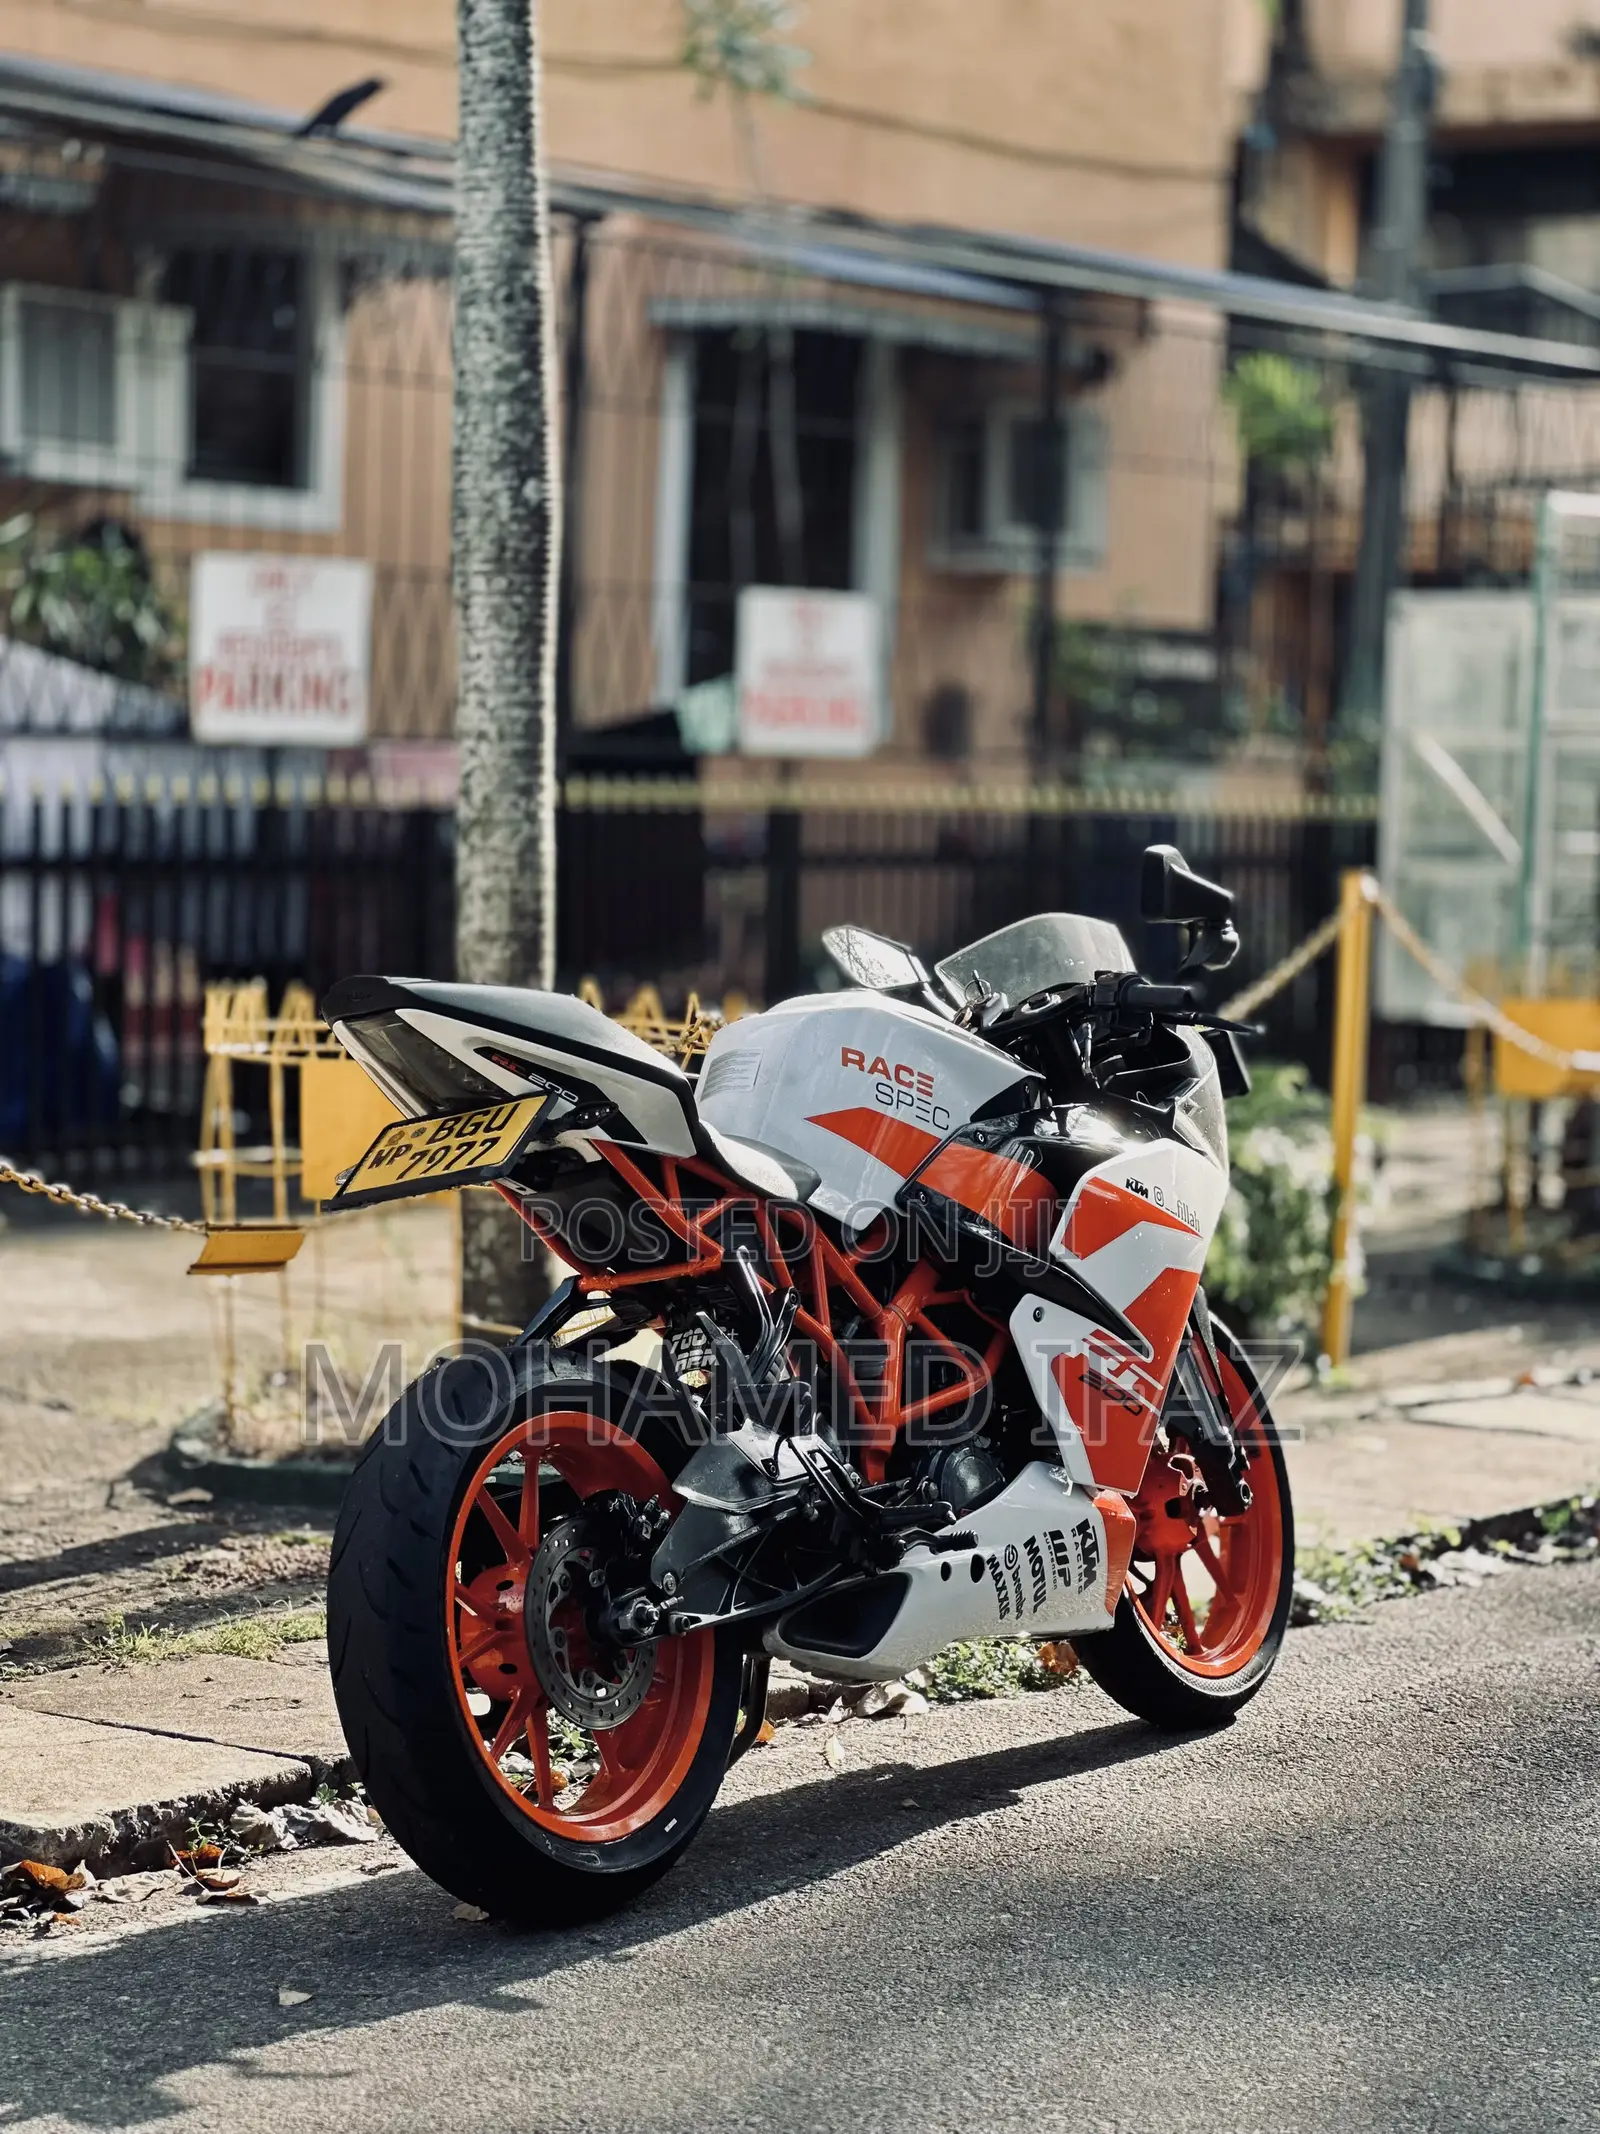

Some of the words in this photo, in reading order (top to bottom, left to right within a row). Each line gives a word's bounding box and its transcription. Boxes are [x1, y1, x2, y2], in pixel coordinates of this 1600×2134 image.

[528, 1072, 579, 1103] 200
[841, 1046, 935, 1098] RACE
[425, 1102, 521, 1146] BGU
[875, 1082, 950, 1131] SPEC
[367, 1143, 414, 1170] WP
[396, 1136, 502, 1181] 7977
[1125, 1177, 1149, 1200] KTM
[1078, 1368, 1143, 1416] 200
[1022, 1534, 1047, 1614] MOTUL
[1070, 1527, 1083, 1595] RACING
[1076, 1518, 1100, 1591] KTM
[986, 1553, 1011, 1620] MAXXIS
[1011, 1564, 1027, 1620] brembo
